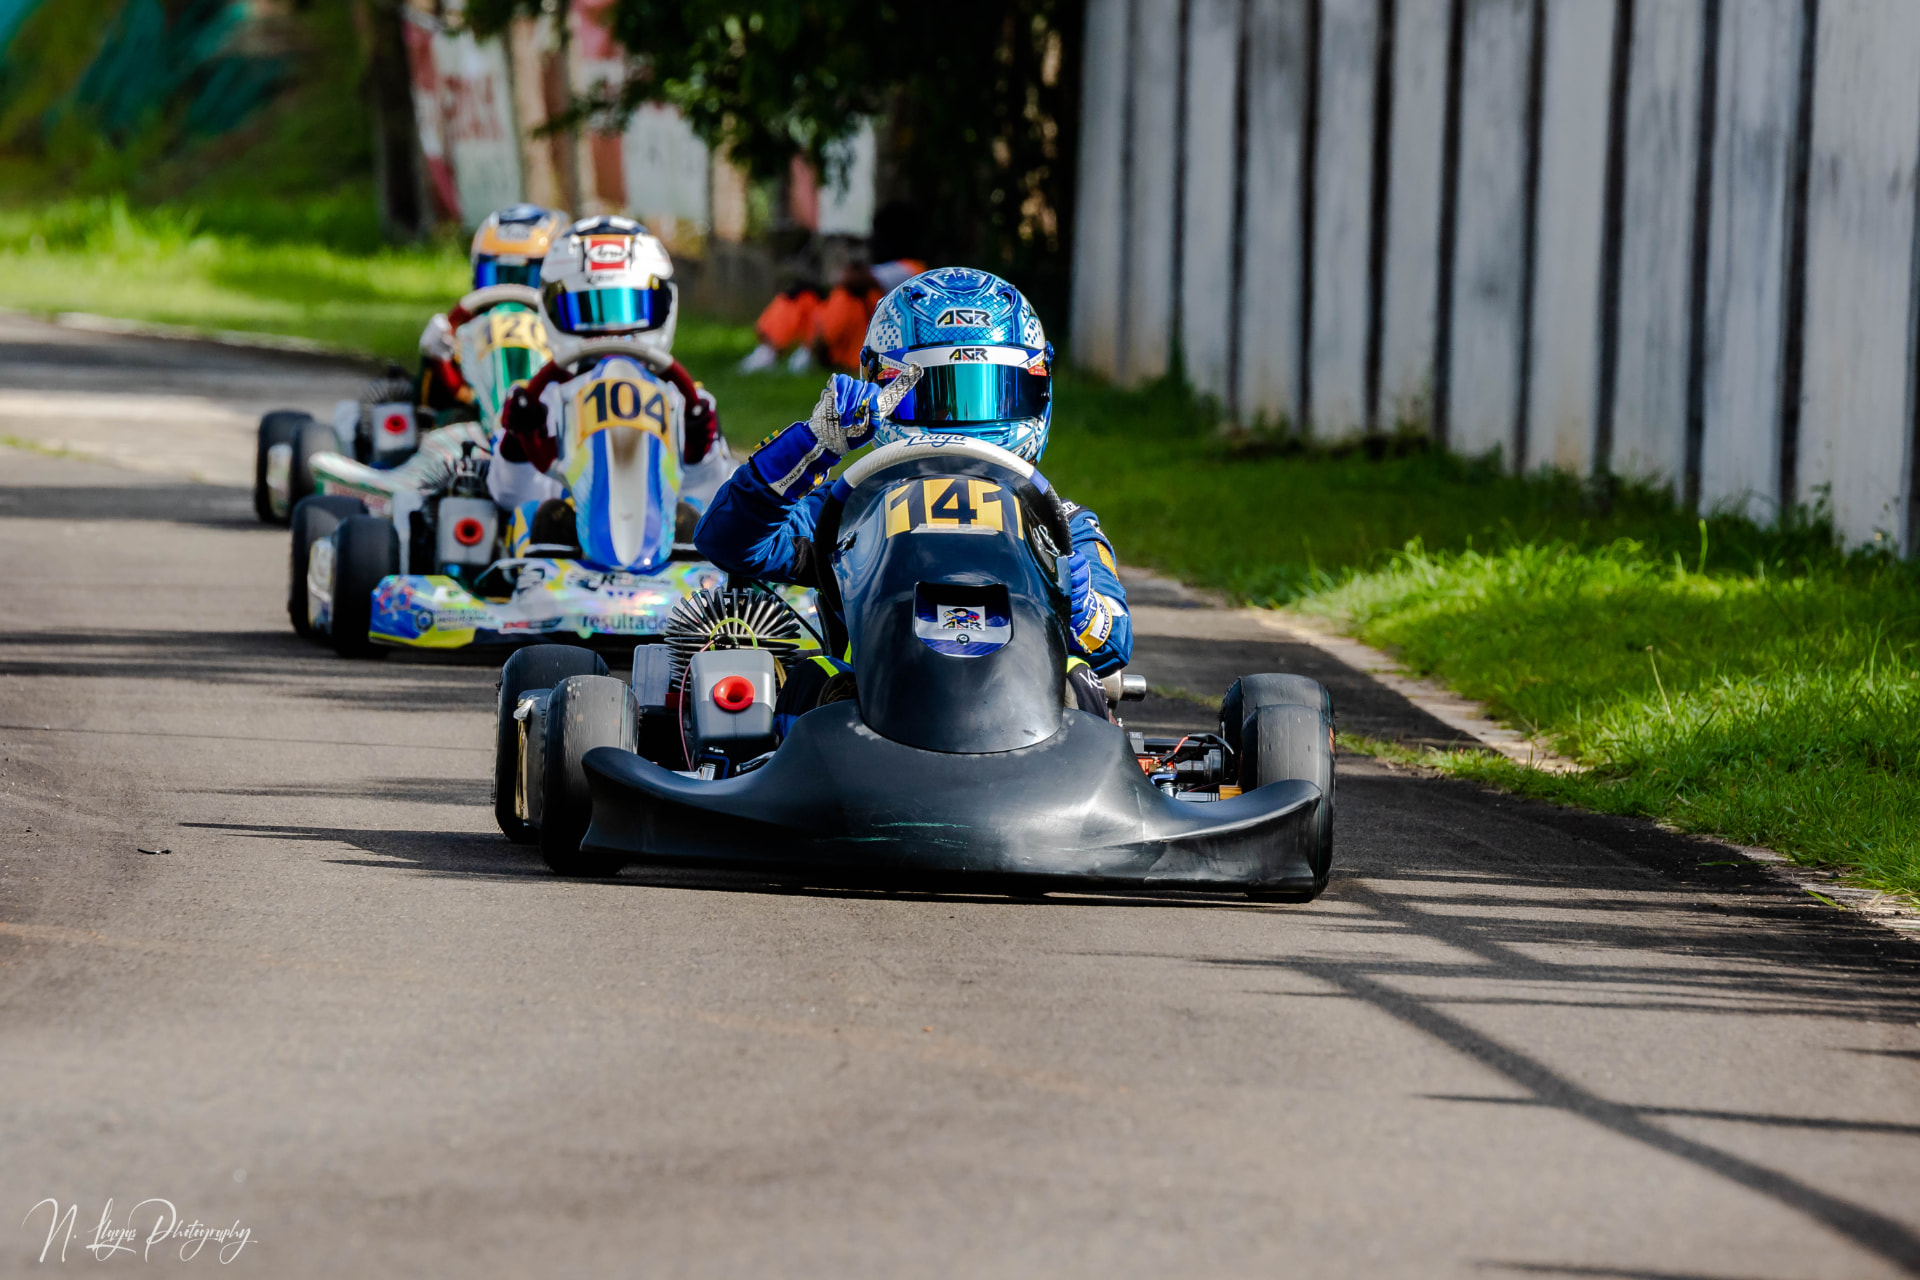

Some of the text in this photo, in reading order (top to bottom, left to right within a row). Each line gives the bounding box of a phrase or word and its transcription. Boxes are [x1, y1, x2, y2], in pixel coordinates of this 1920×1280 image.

[937, 309, 991, 326] AGR
[949, 348, 988, 361] AGR
[583, 381, 667, 435] 104
[890, 479, 1021, 535] 141
